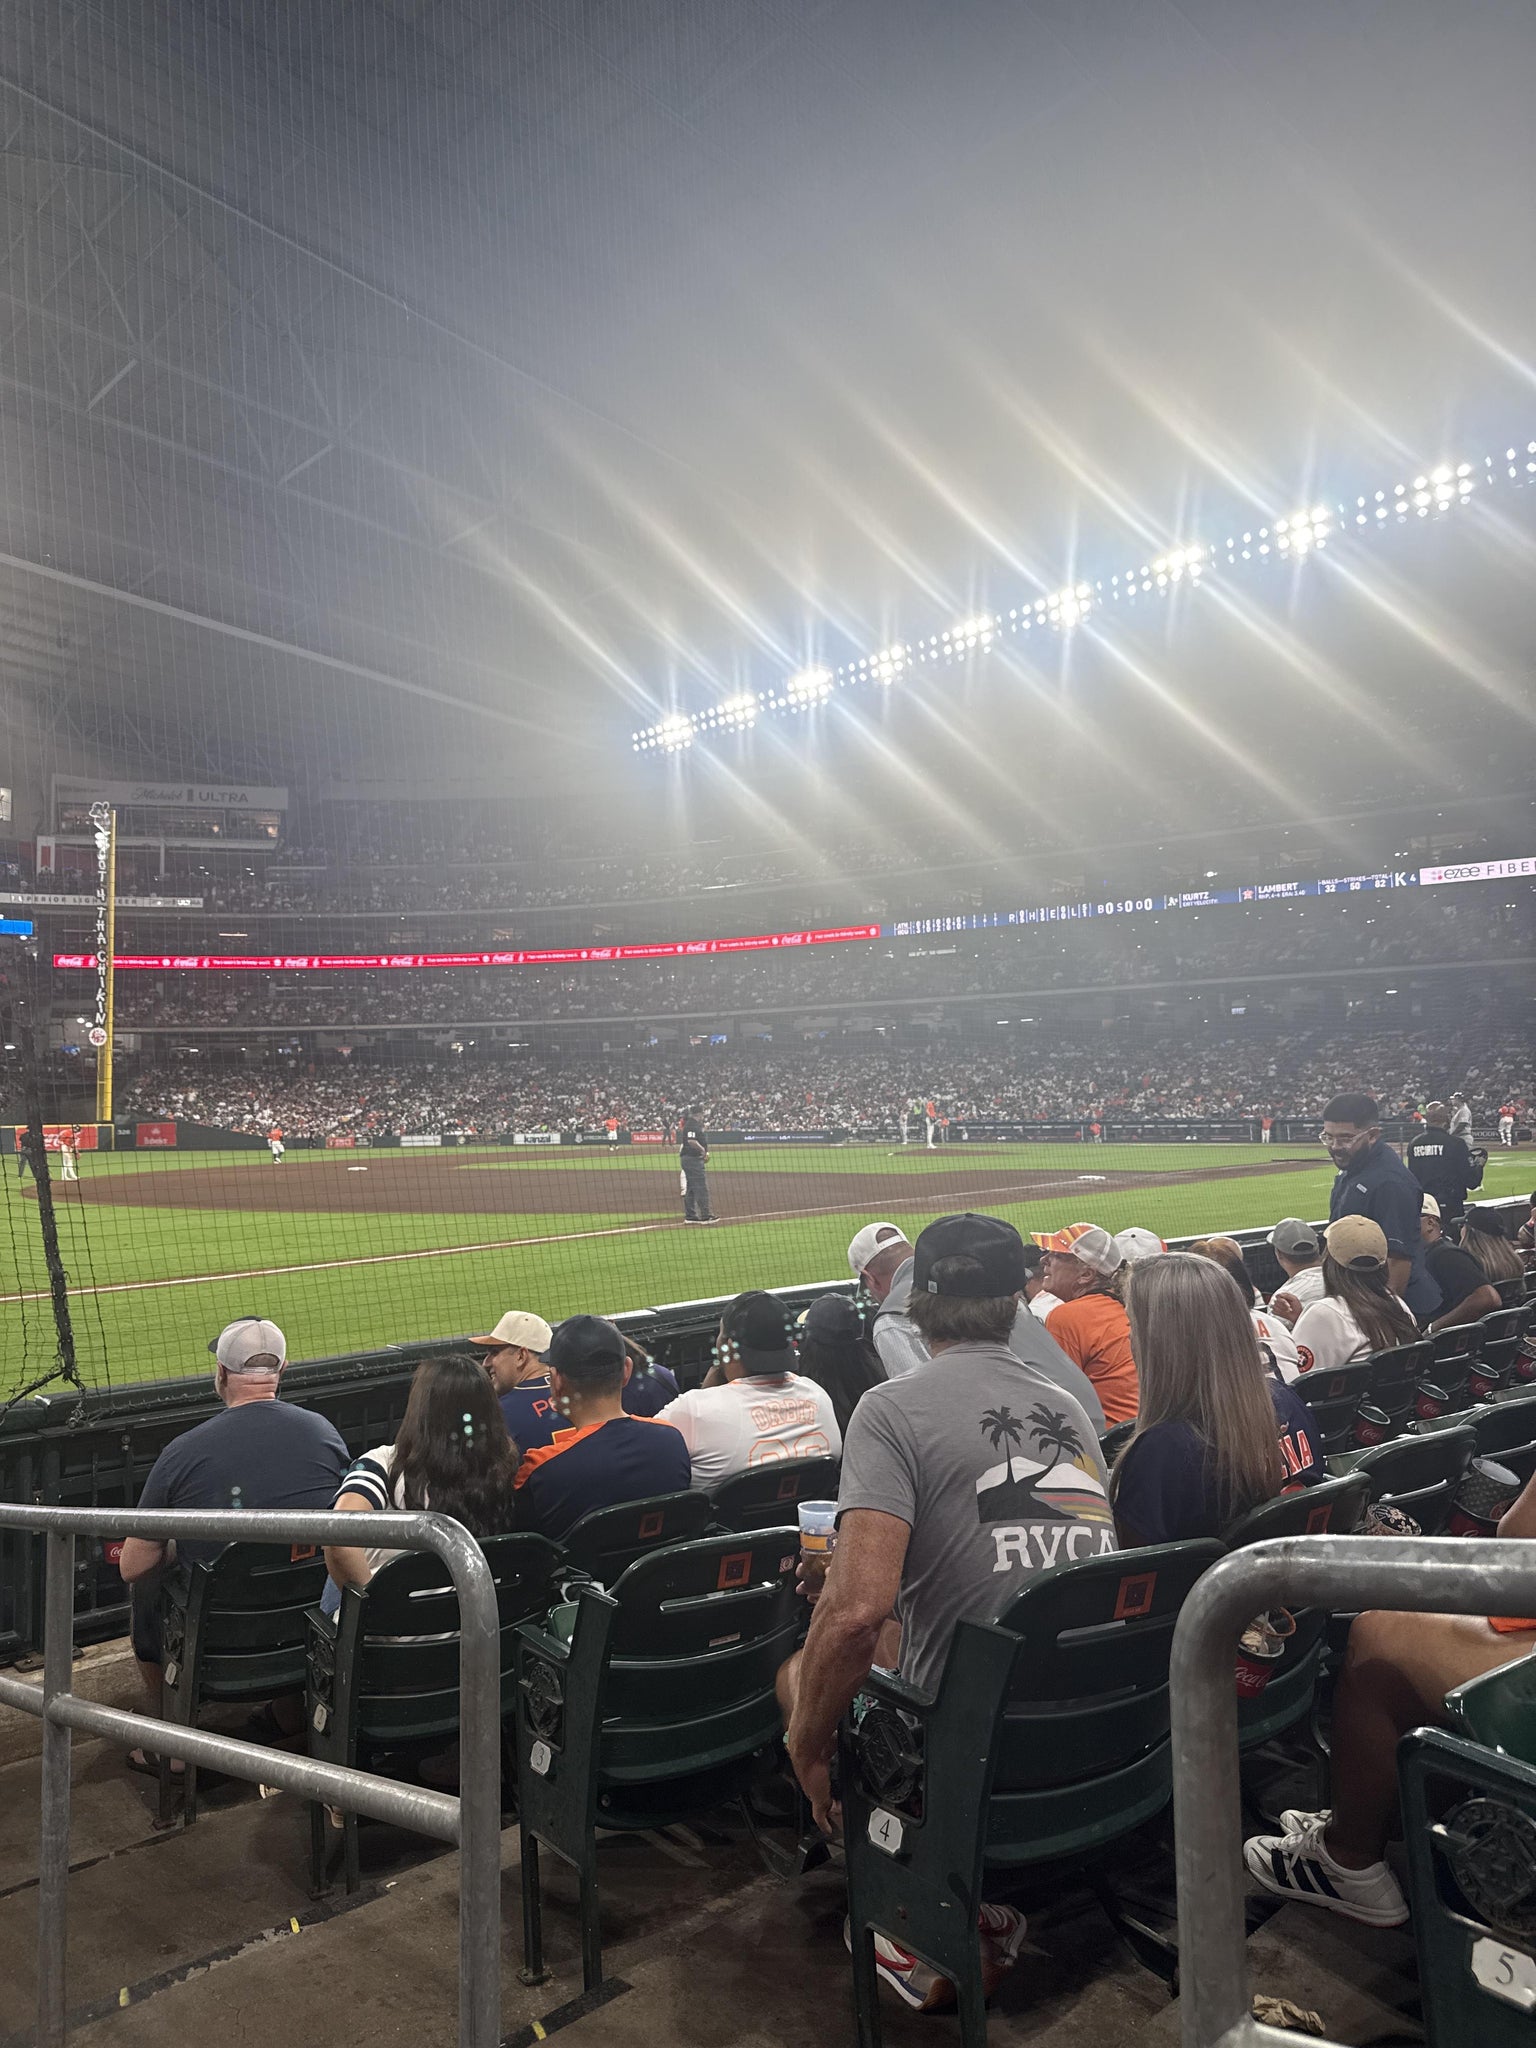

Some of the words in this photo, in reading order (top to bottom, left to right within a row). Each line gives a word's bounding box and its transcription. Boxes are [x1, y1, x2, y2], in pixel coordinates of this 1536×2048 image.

[199, 791, 248, 802] ULTRA
[1444, 866, 1480, 879] ezee
[1487, 861, 1536, 875] FIBE
[1325, 884, 1336, 893] 32
[1375, 880, 1386, 888] 82
[1394, 872, 1407, 886] K
[1182, 892, 1209, 901] KURTZ
[1258, 882, 1299, 894] LAMBERT
[1009, 913, 1016, 922] R
[1029, 912, 1035, 920] H
[1050, 909, 1056, 918] E
[1071, 908, 1077, 916] L
[1098, 905, 1104, 913] B
[1105, 902, 1114, 915] 0
[1117, 903, 1123, 912] S
[1124, 900, 1133, 912] 0
[1144, 898, 1152, 911] 0
[96, 907, 107, 945] THA
[95, 950, 107, 1025] CHIKIN
[1413, 1144, 1444, 1157] SECURITY
[751, 1398, 818, 1432] ORBIT
[317, 1708, 324, 1725] 2
[536, 1747, 545, 1766] 3
[879, 1819, 890, 1842] 4
[1495, 1952, 1516, 1985] 5
